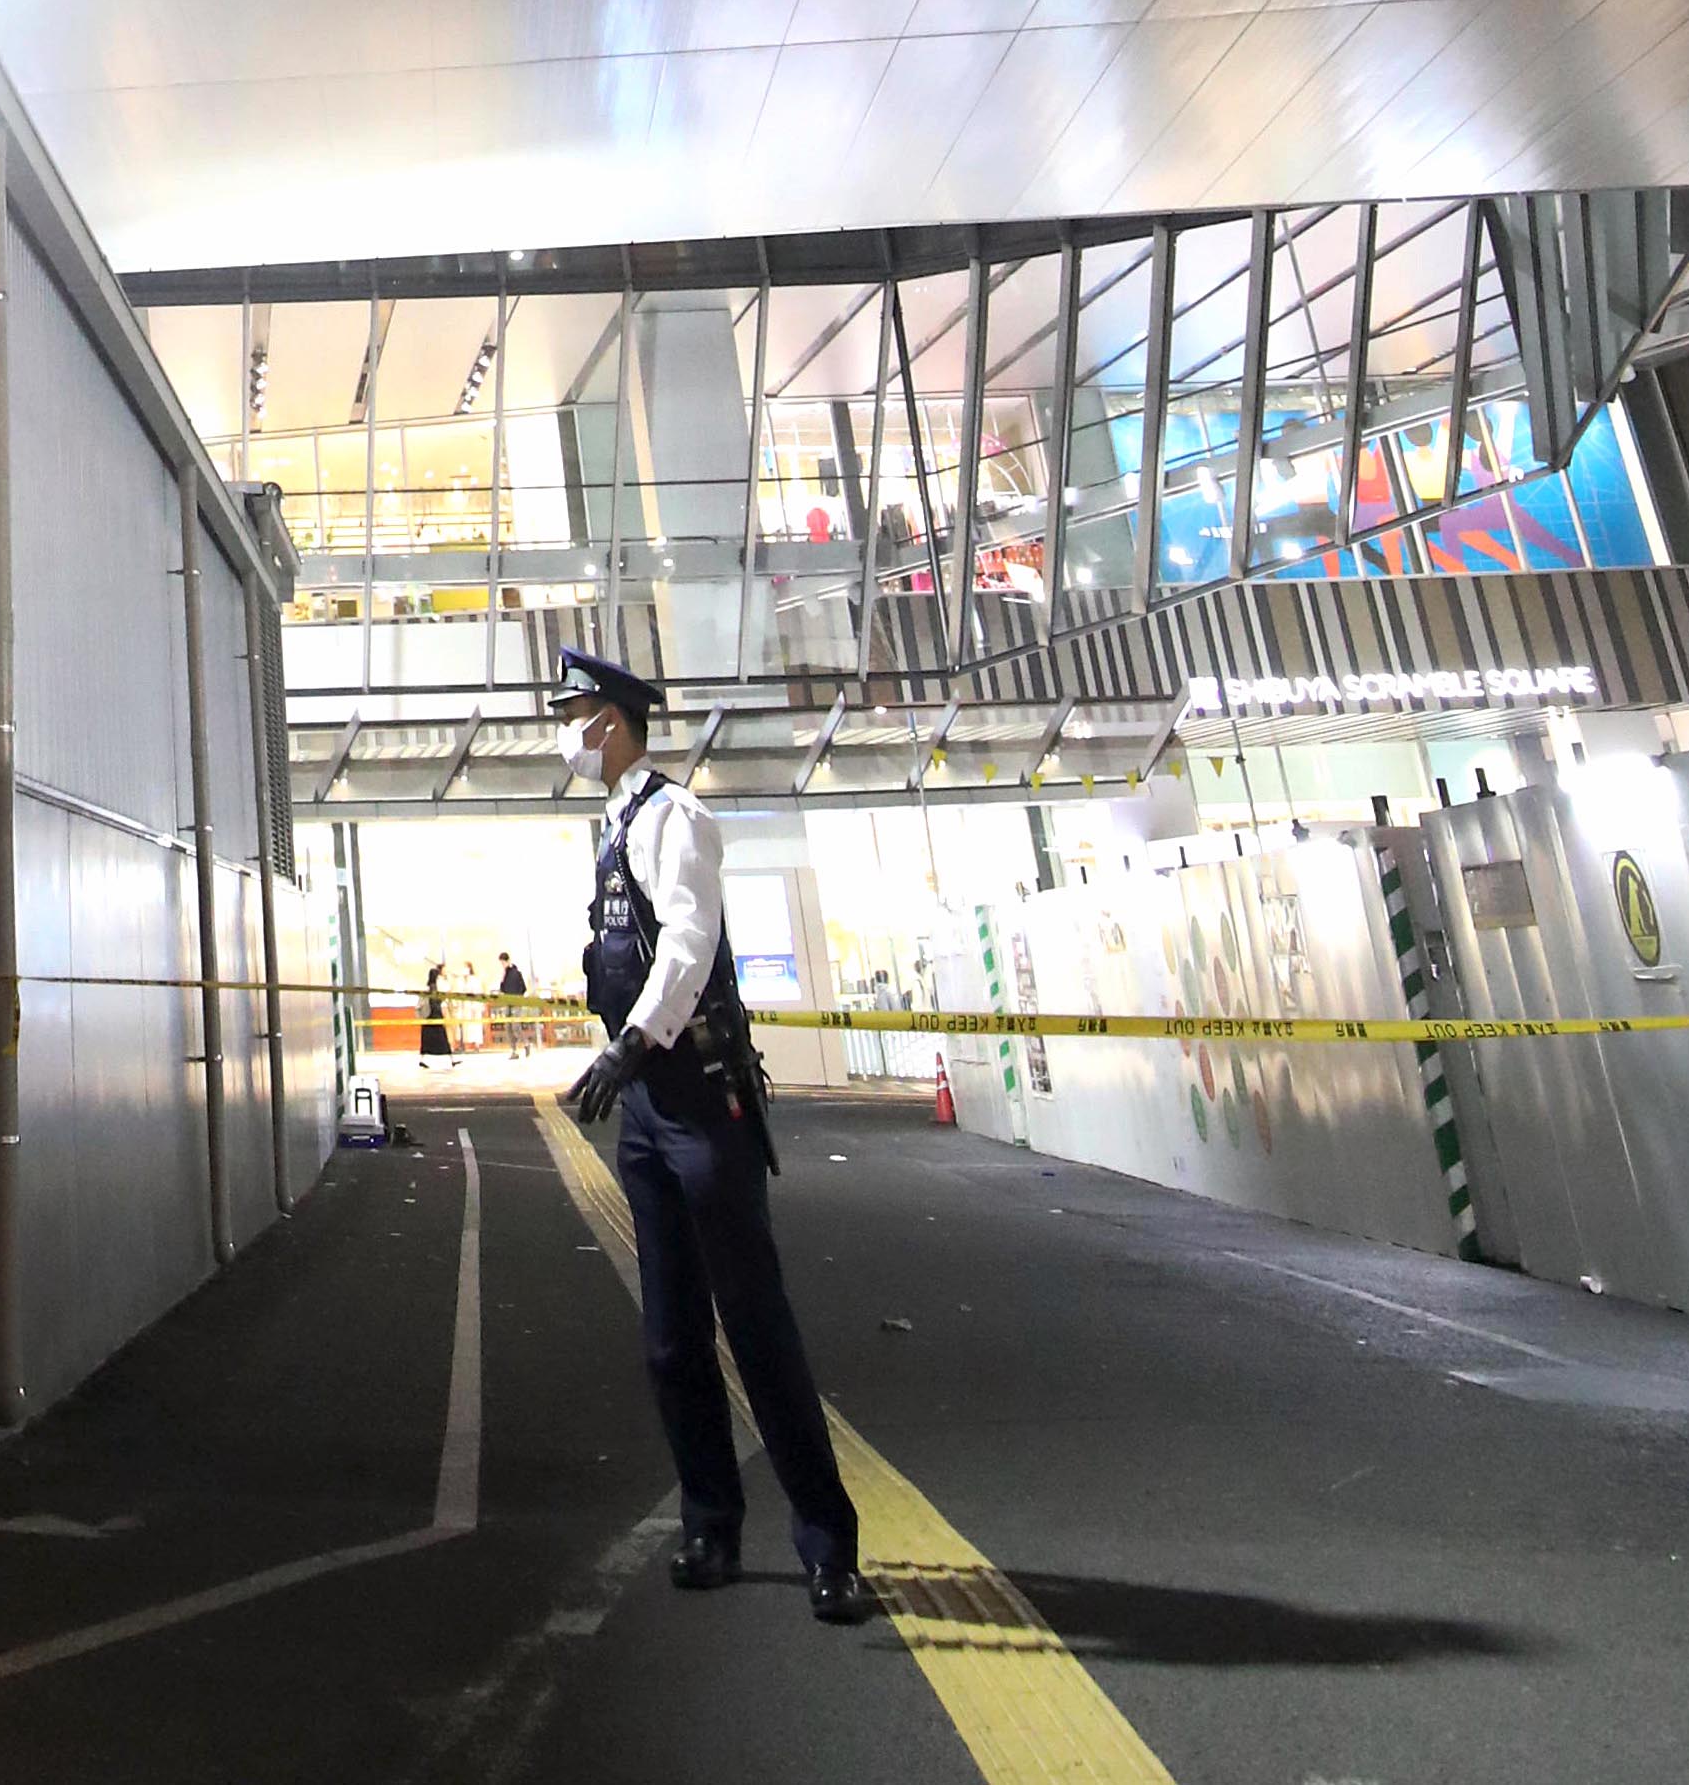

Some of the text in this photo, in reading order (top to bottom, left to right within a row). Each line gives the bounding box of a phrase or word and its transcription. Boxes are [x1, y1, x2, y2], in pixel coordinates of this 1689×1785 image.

[1225, 667, 1596, 706] SHIBUYA SCRAMBLE SQUARE
[910, 1014, 940, 1031] OUT
[947, 1016, 988, 1032] KEEP
[1164, 1020, 1195, 1036] OUT
[1202, 1020, 1244, 1037] KEEP
[1464, 1022, 1508, 1038] KEEP
[1424, 1023, 1458, 1039] OUT
